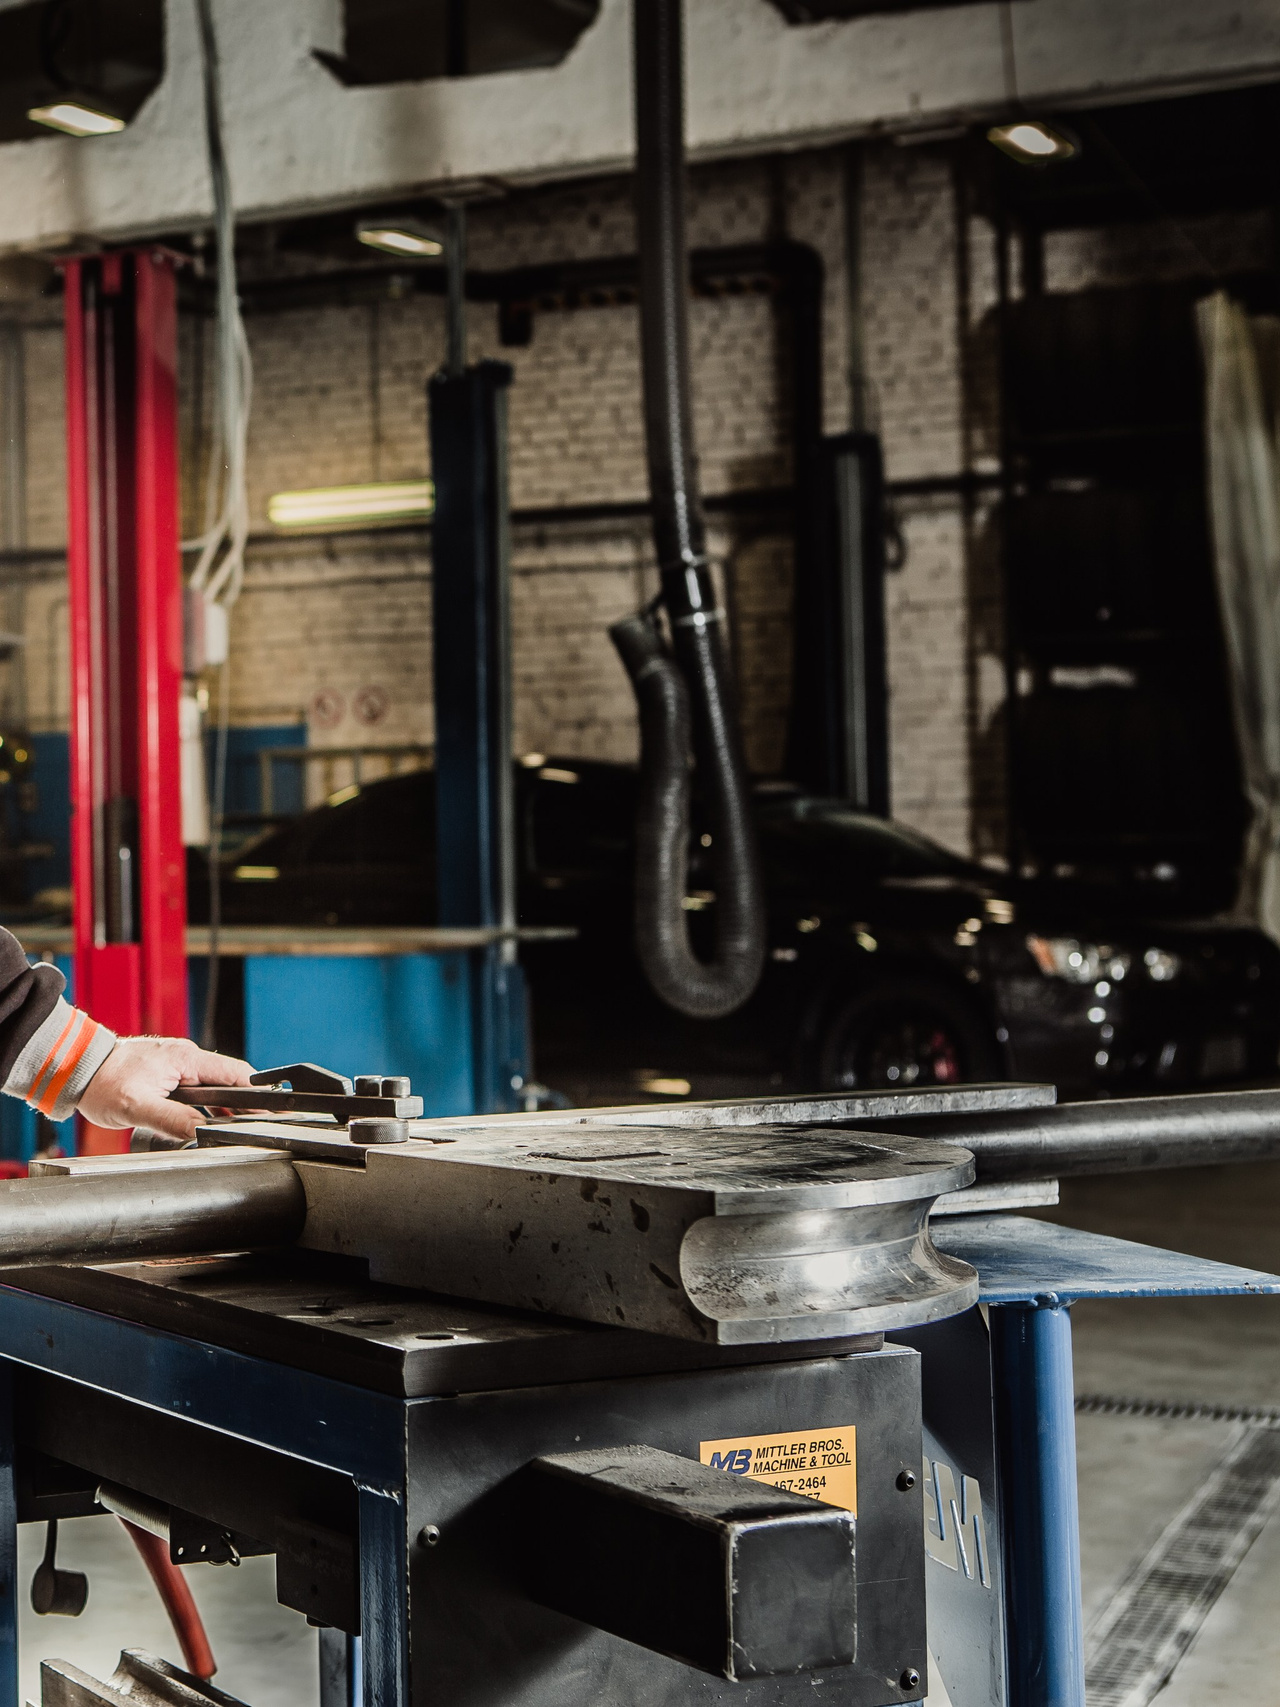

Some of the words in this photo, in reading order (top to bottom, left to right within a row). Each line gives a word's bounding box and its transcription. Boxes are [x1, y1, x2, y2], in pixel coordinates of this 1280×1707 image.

[709, 1448, 753, 1475] MB
[755, 1442, 807, 1460] MITTLER
[809, 1438, 845, 1453] BROS.
[753, 1458, 807, 1474] MACHINE
[809, 1455, 818, 1467] &
[821, 1451, 852, 1466] TOOL
